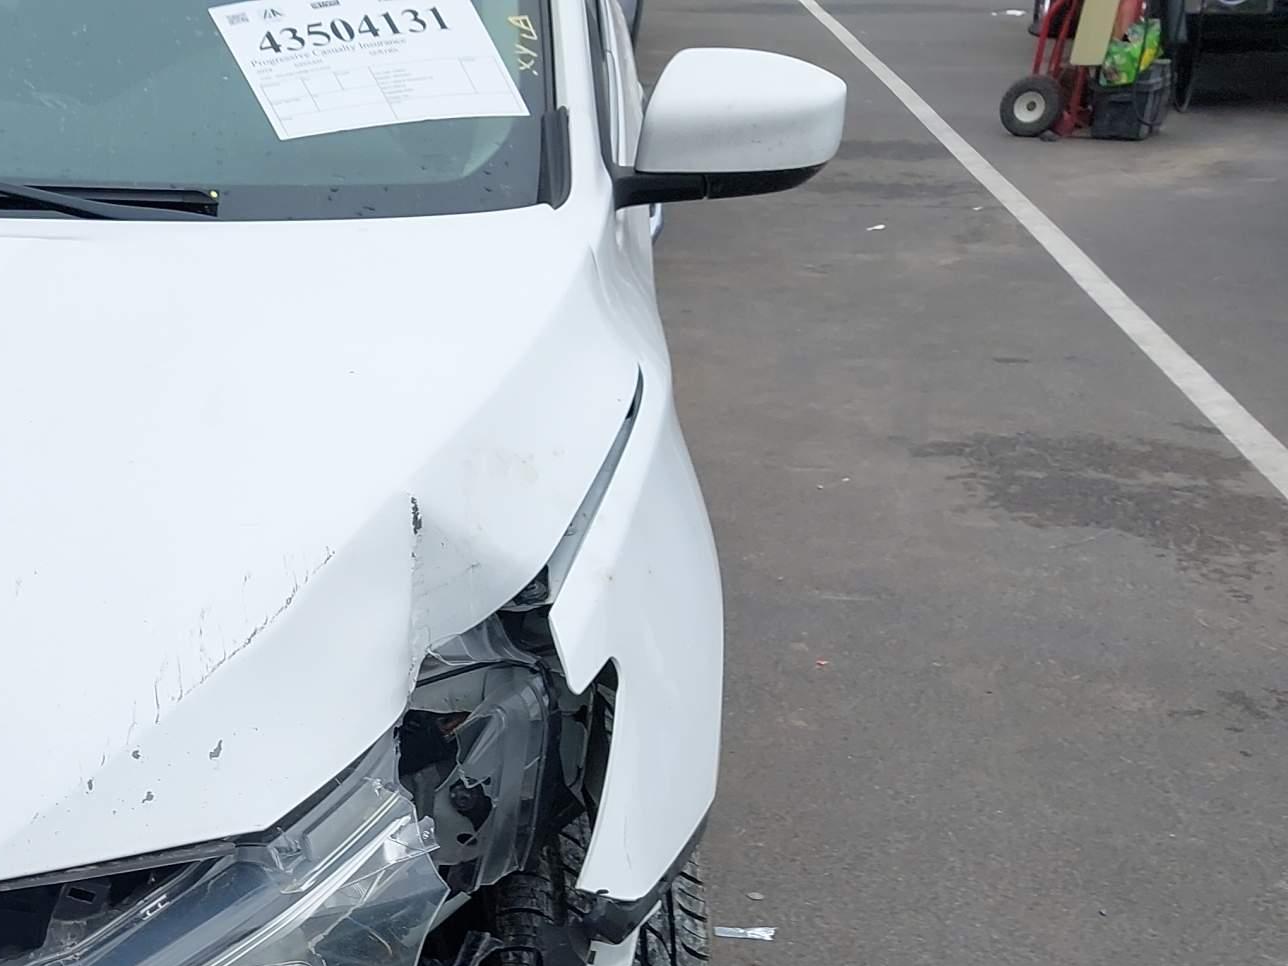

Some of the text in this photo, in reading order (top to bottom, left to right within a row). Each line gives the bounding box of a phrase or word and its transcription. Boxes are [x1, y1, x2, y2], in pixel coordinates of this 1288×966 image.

[259, 7, 450, 54] 43504131
[250, 51, 310, 68] Progressive
[312, 42, 357, 57] Casualty
[358, 37, 407, 50] Insurance
